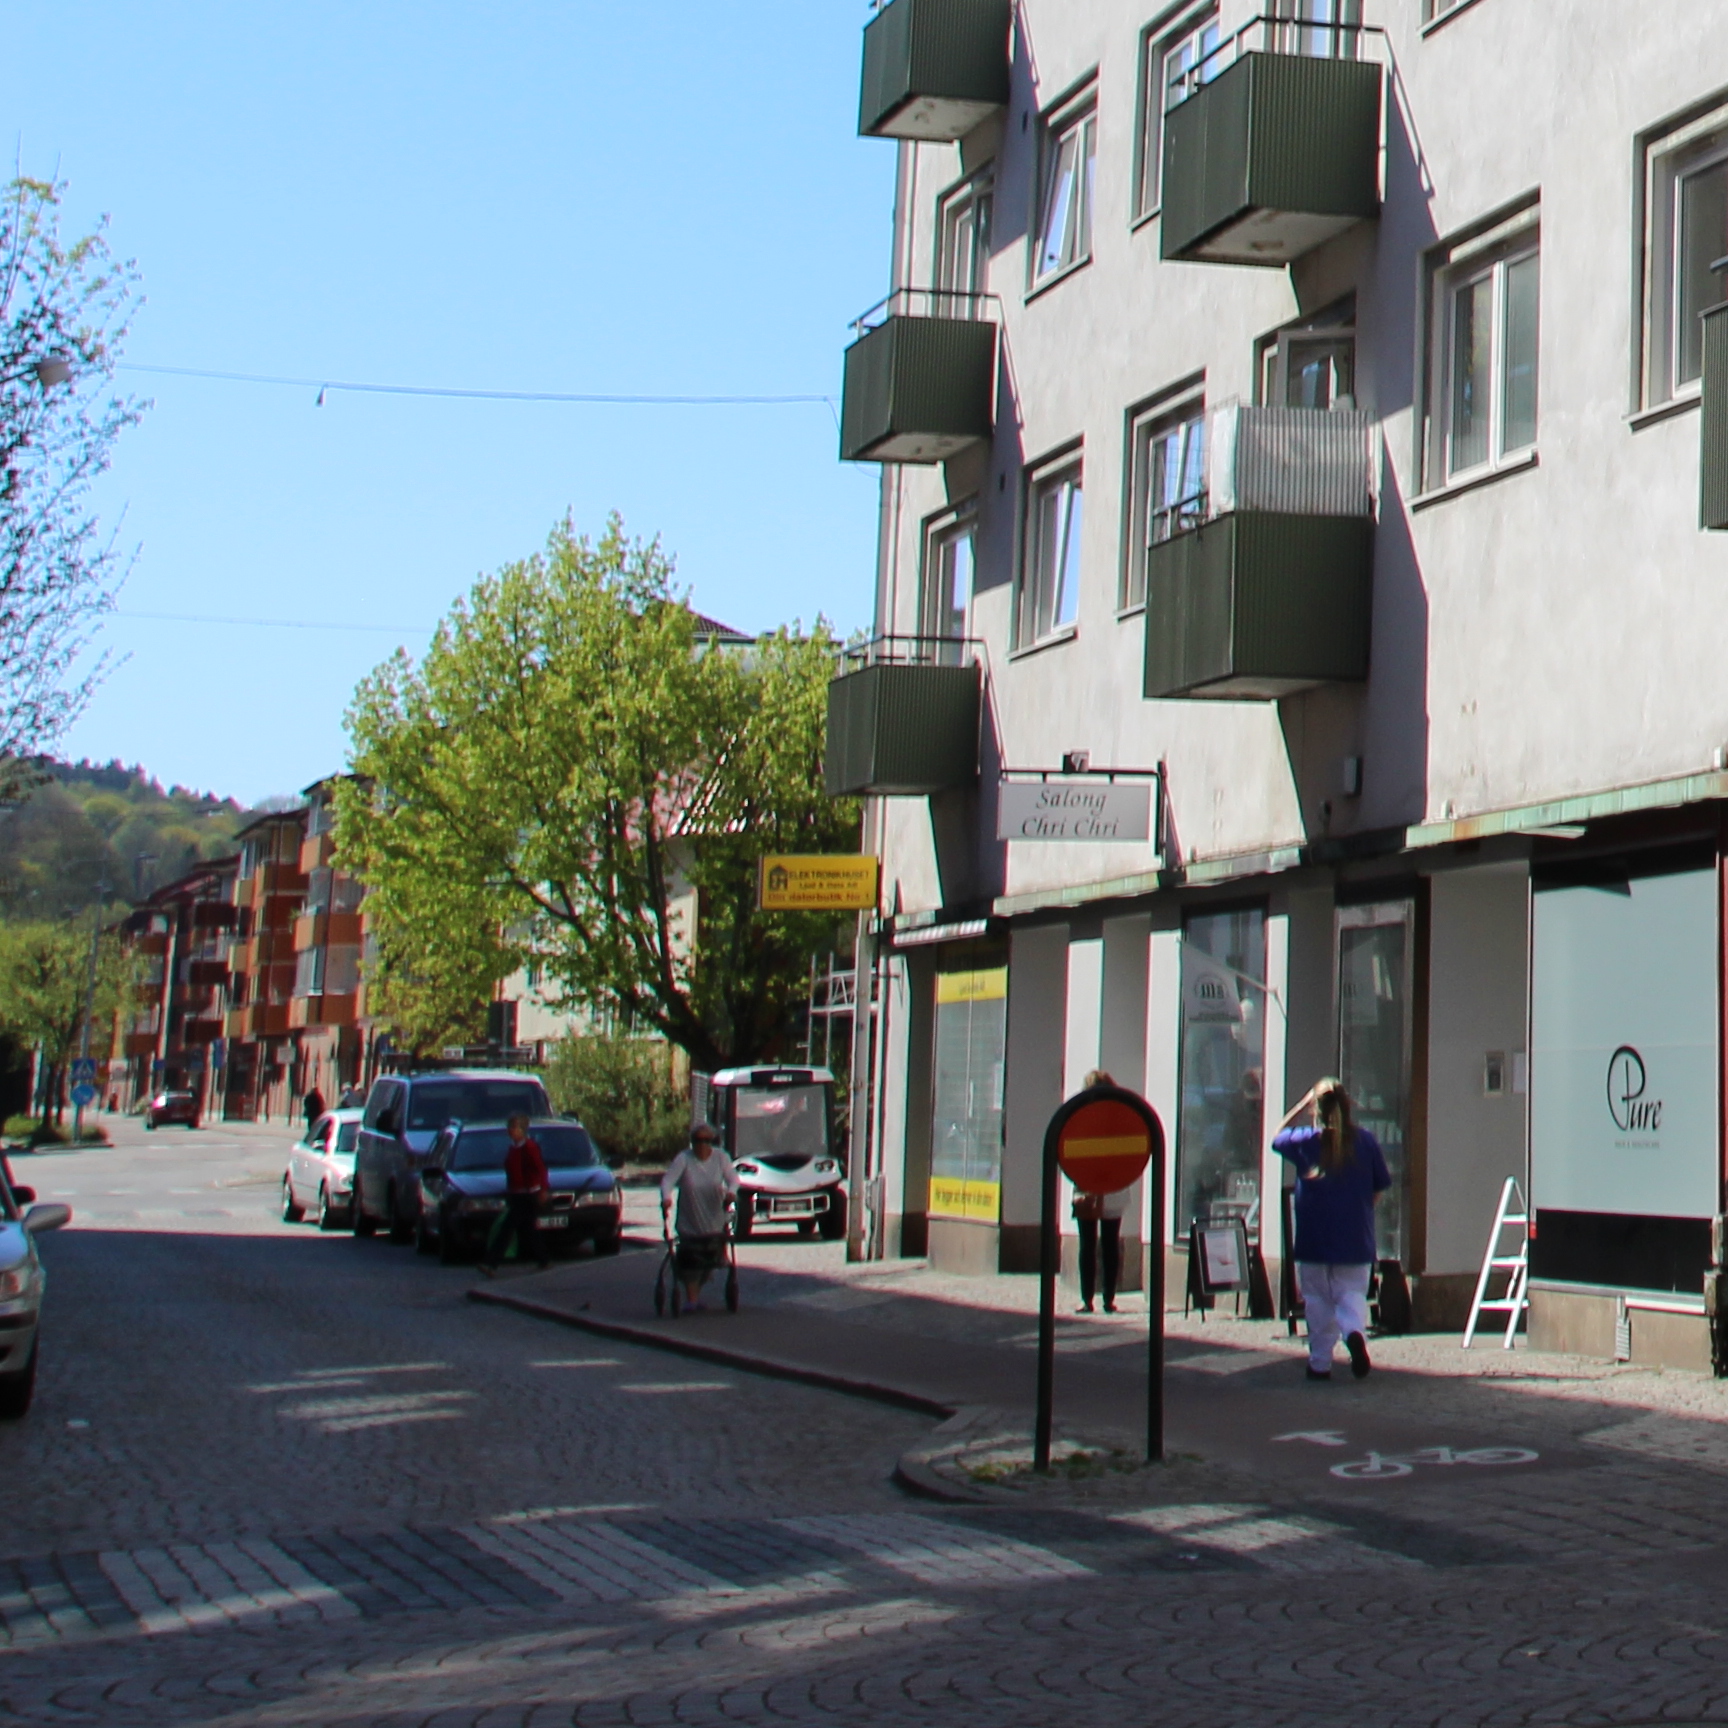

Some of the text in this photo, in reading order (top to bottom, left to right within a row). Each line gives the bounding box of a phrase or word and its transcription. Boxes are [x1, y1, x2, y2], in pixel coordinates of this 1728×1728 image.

[1036, 788, 1107, 817] Salong
[1021, 817, 1119, 836] Chri Chri
[1607, 1045, 1662, 1131] Pure
